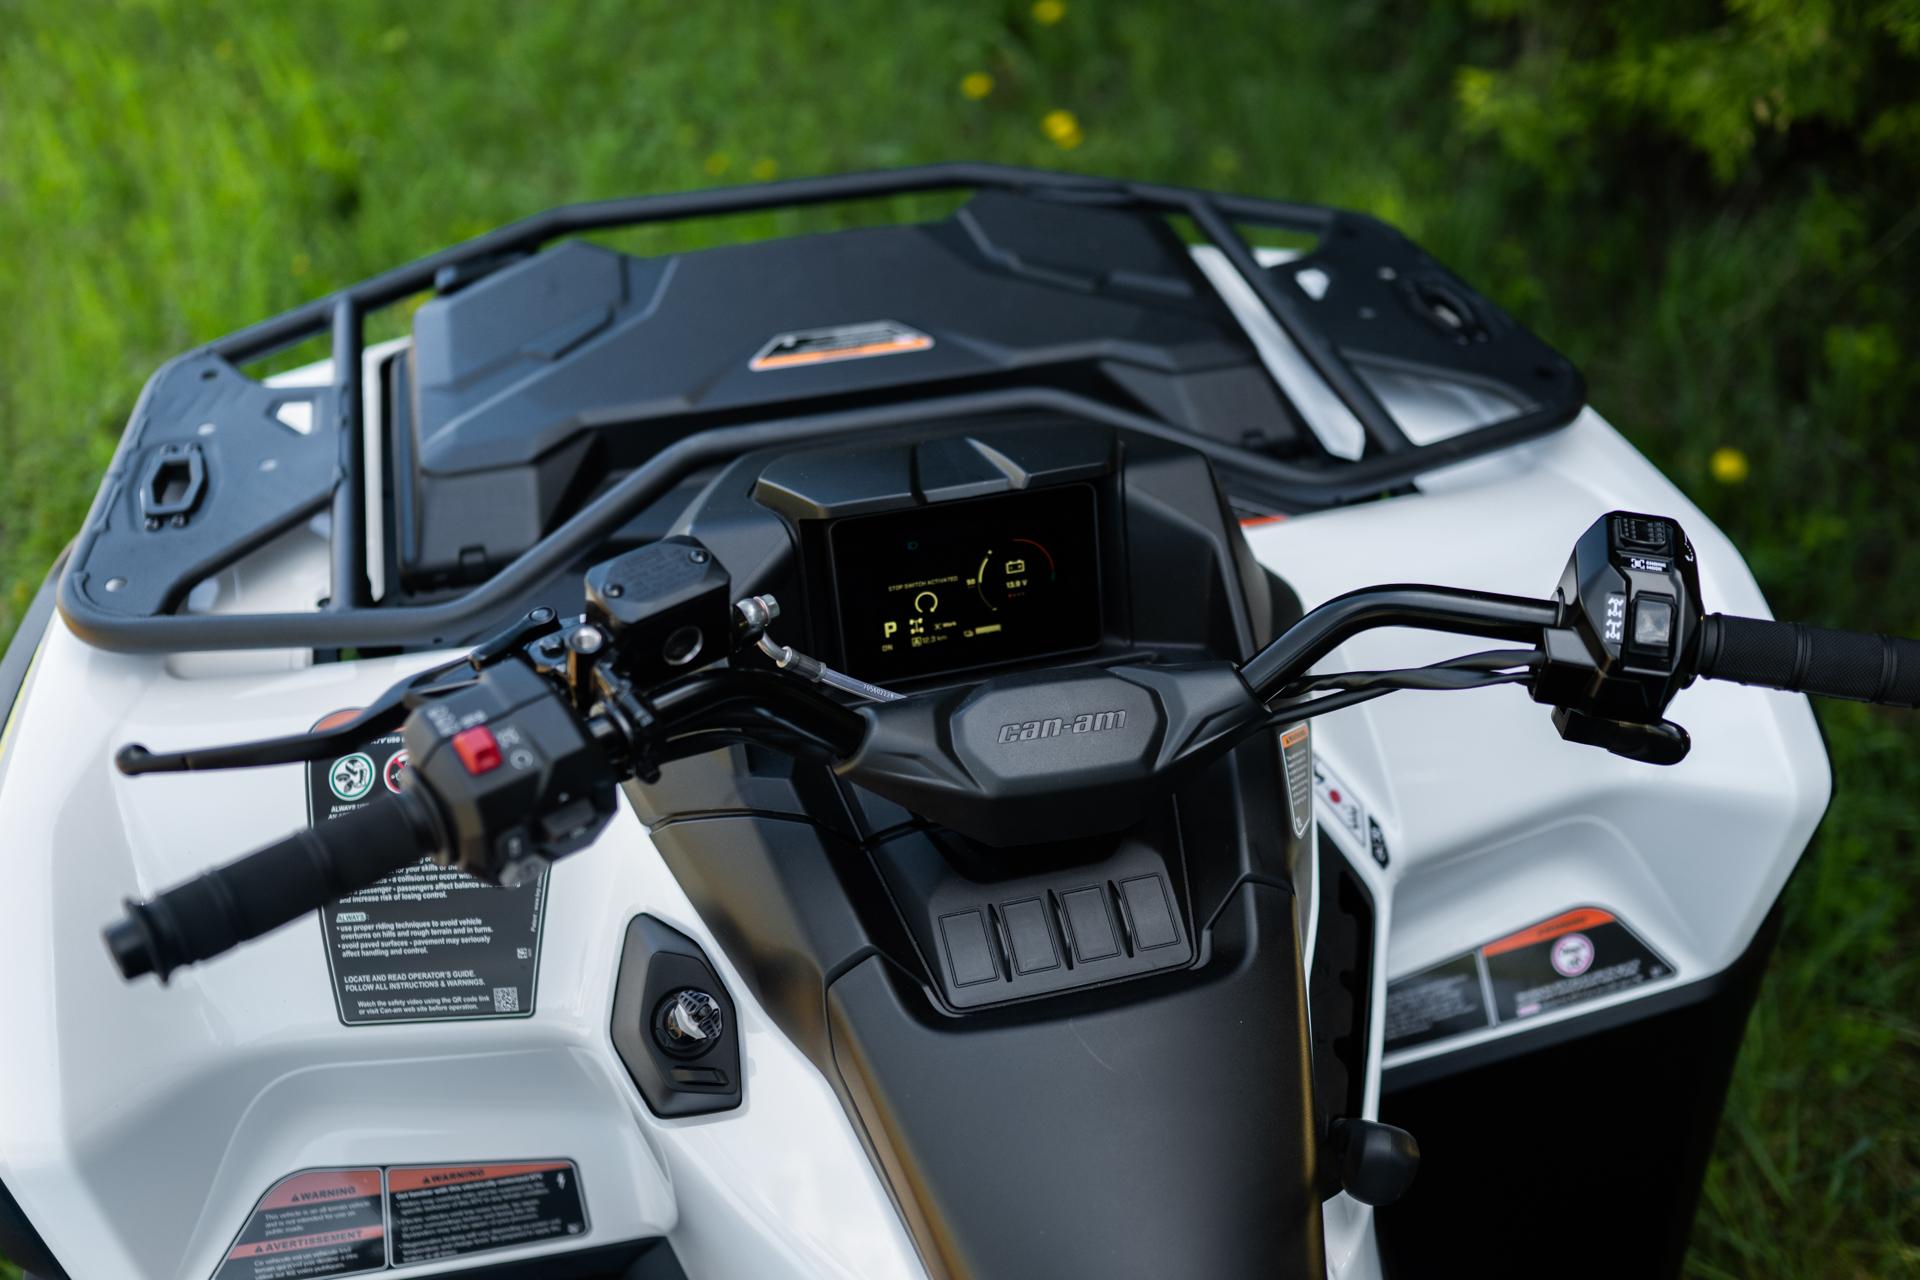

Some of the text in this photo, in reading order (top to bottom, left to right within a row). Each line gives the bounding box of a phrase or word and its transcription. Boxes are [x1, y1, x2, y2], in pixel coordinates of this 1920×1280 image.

[888, 575, 958, 592] STOP SWITCH ACTIVATED
[884, 621, 897, 638] P
[882, 644, 893, 652] ON
[997, 710, 1126, 744] can-am
[331, 804, 356, 813] ALWAYS
[405, 866, 420, 874] your
[421, 864, 438, 872] skills
[398, 874, 424, 882] collision
[359, 886, 392, 895] passenger
[397, 884, 434, 893] passengers
[435, 882, 454, 890] affect
[454, 881, 479, 889] balance
[352, 895, 379, 903] increase
[380, 893, 392, 901] risk
[402, 892, 421, 901] losing
[423, 891, 447, 899] control.
[338, 913, 365, 921] ALWAYS
[353, 924, 375, 932] proper
[375, 922, 394, 931] riding
[395, 921, 431, 929] techniques
[459, 917, 482, 926] vehicle
[340, 932, 371, 940] overturns
[410, 929, 429, 938] rough
[360, 940, 380, 949] paved
[381, 939, 408, 947] surfaces
[413, 938, 445, 947] pavement
[446, 938, 460, 946] may
[461, 935, 490, 944] seriously
[342, 950, 360, 958] affect
[361, 949, 389, 957] handling
[403, 947, 428, 955] control.
[344, 970, 476, 983] LOCATE AND READ OPERATOR'S GUIDE.
[345, 984, 374, 992] FOLLOW
[375, 983, 388, 991] ALL
[389, 980, 439, 990] INSTRUCTIONS
[446, 978, 486, 987] WARNINGS.
[357, 1000, 376, 1008] Watch
[388, 999, 406, 1007] safety
[406, 998, 423, 1006] video
[452, 996, 462, 1004] QR
[449, 1004, 478, 1012] operation.
[431, 1169, 484, 1182] WARNING
[300, 1186, 357, 1201] WARNING
[280, 1211, 302, 1220] vehicle
[266, 1230, 363, 1252] AVERTISSEMENT
